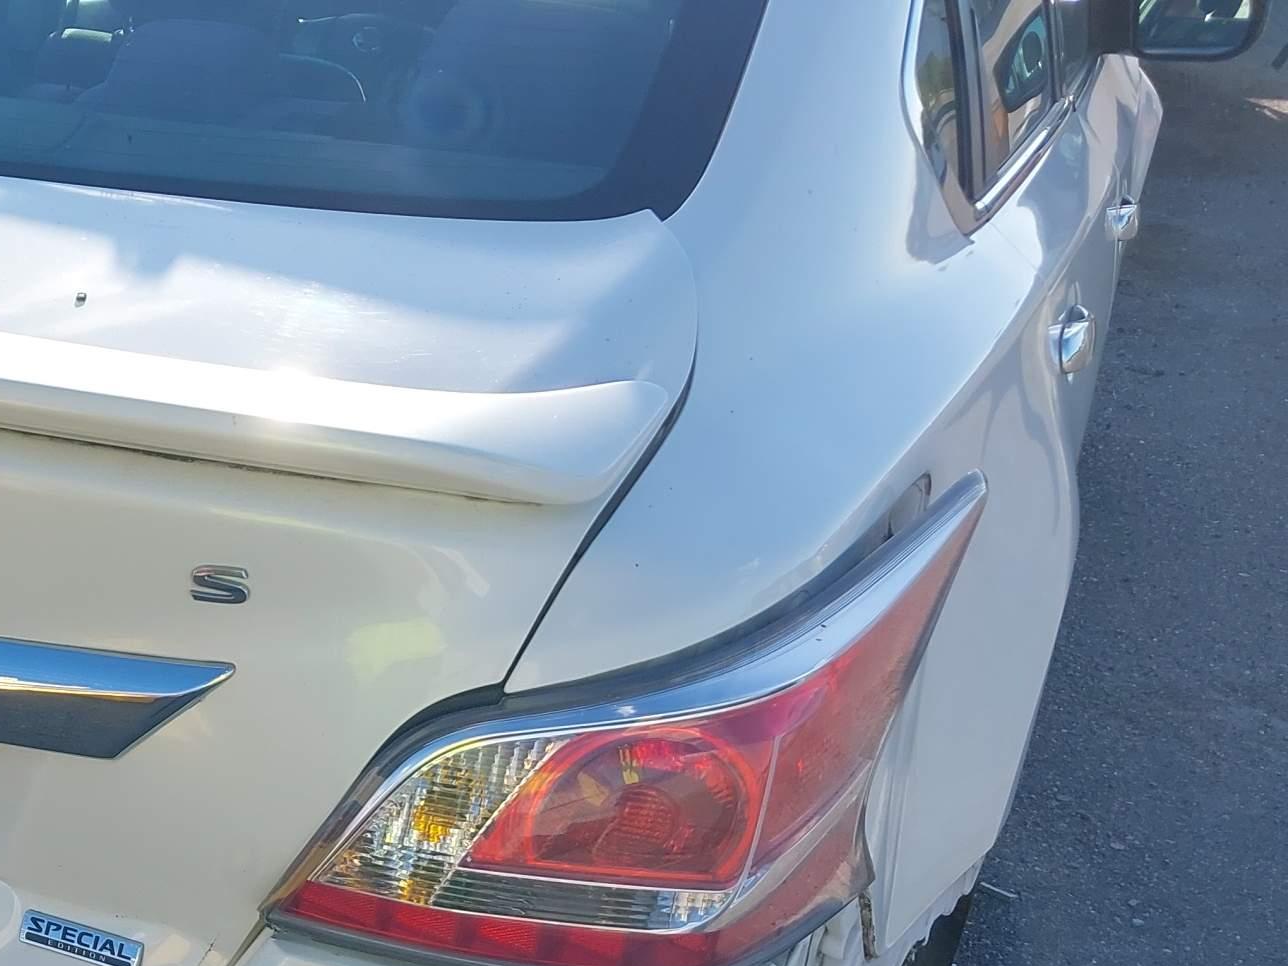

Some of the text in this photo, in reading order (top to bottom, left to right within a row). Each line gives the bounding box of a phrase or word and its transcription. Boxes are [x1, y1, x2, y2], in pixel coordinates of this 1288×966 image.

[190, 563, 250, 605] S
[26, 916, 132, 961] SPECIAL
[46, 937, 107, 963] EDITION
